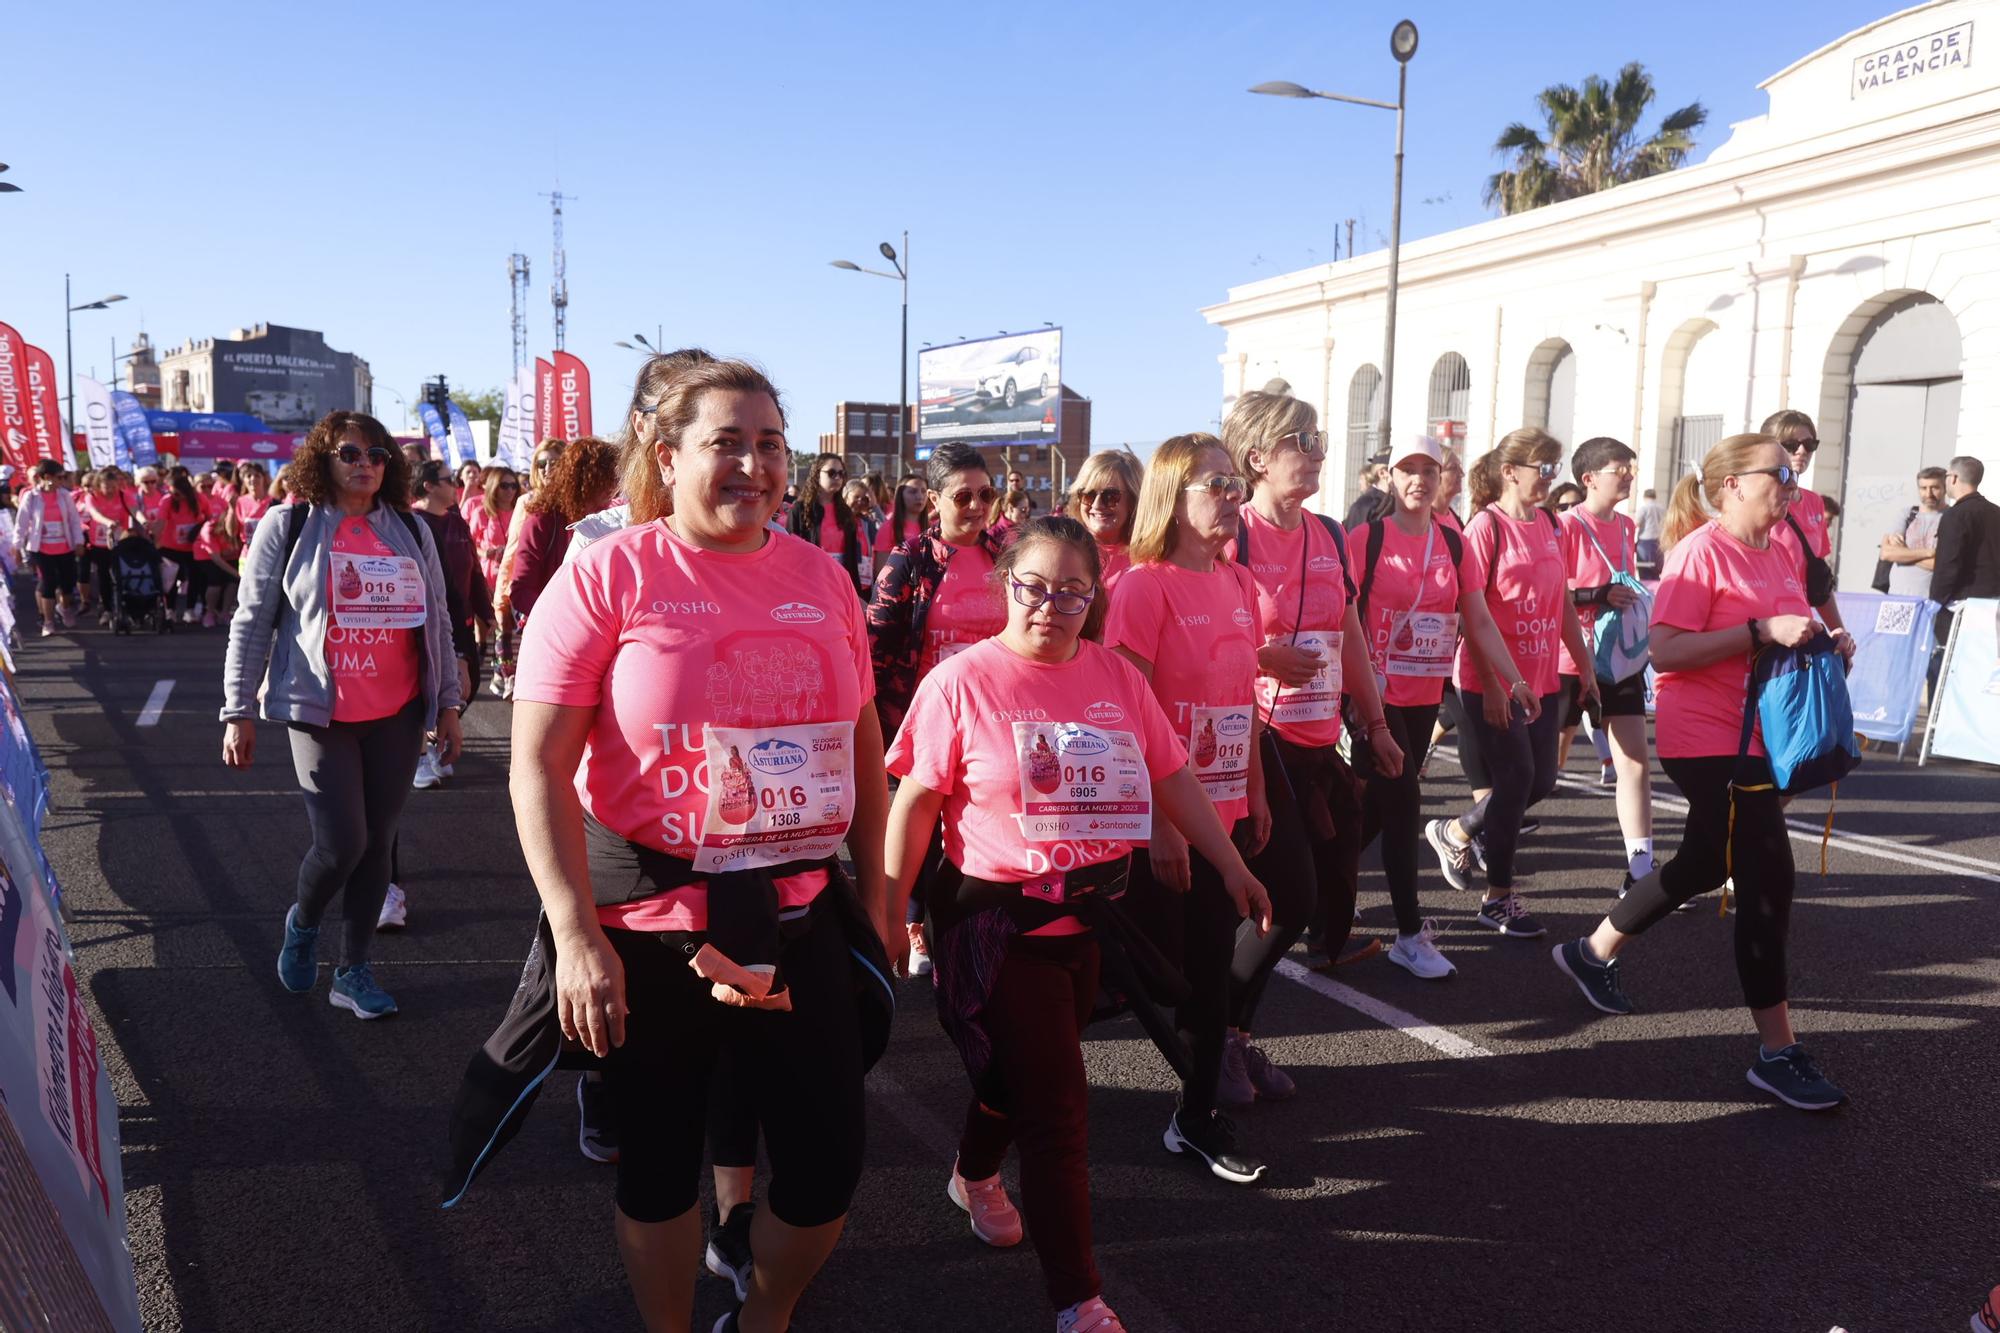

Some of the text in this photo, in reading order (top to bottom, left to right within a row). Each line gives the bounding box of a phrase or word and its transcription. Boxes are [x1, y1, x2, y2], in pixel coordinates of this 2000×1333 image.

[1863, 31, 1960, 72] GRAO DE
[1858, 49, 1962, 91] VALENCIA
[236, 352, 274, 366] PUERTO
[1252, 564, 1287, 574] OYSHO
[364, 582, 396, 594] 016
[370, 595, 391, 603] 6904
[652, 600, 721, 615] OYSHO
[1514, 598, 1537, 615] TU
[930, 630, 957, 646] TU
[1415, 636, 1438, 649] 016
[1282, 695, 1310, 703] CARRERA
[991, 708, 1047, 723] OYSHO
[1281, 708, 1312, 717] OYSHO
[811, 742, 843, 752] SUMA
[1111, 739, 1132, 748] SUMA
[1218, 743, 1244, 758] 016
[752, 753, 804, 766] ASTURIANA
[1222, 760, 1238, 769] 1306
[1064, 765, 1106, 783] 016
[760, 785, 807, 809] 016
[1070, 787, 1097, 798] 6905
[1091, 804, 1119, 812] MUJER
[1120, 804, 1139, 812] 2023
[771, 812, 801, 827] 1308
[1010, 812, 1027, 838] T
[1099, 820, 1142, 830] Santander
[1035, 821, 1070, 832] OYSHO
[721, 835, 763, 846] CARRERA
[764, 834, 777, 842] DE
[777, 832, 789, 840] LA
[789, 829, 818, 839] MUJER
[789, 841, 834, 854] Santander
[712, 846, 756, 865] OYSHO
